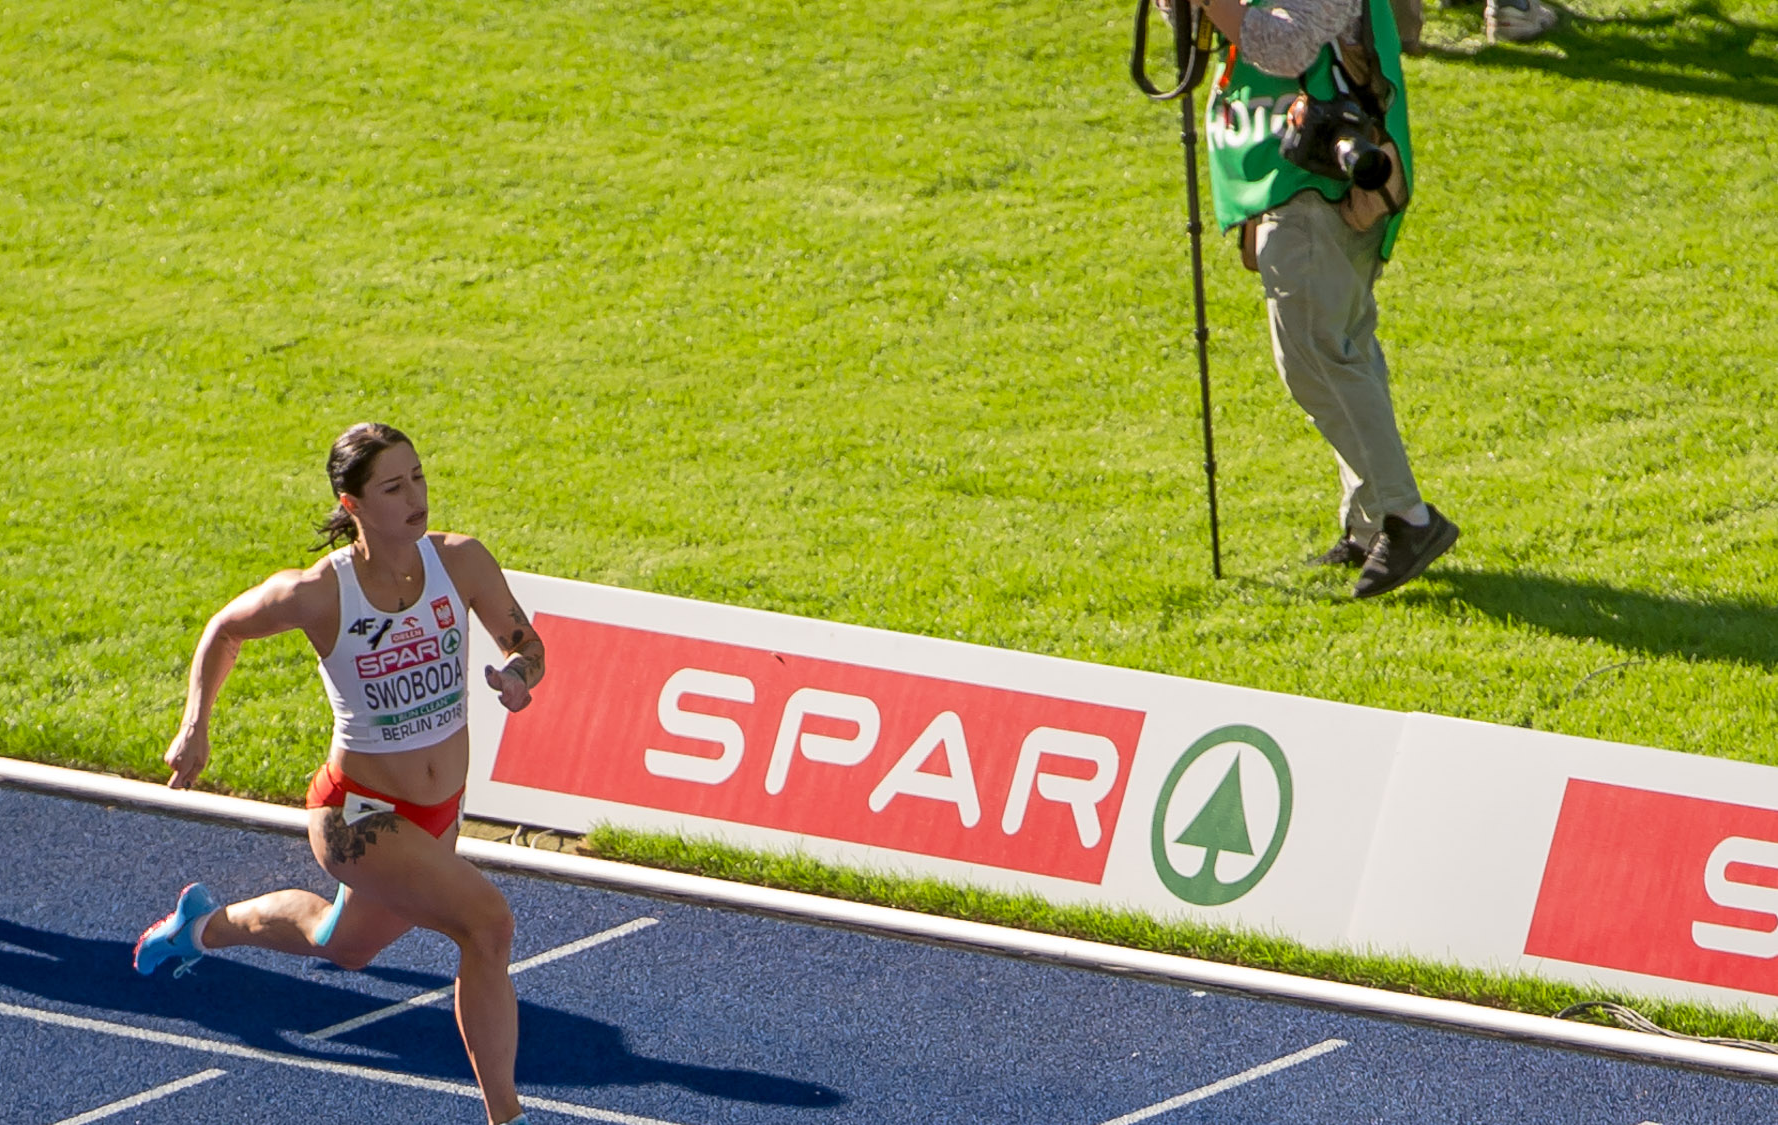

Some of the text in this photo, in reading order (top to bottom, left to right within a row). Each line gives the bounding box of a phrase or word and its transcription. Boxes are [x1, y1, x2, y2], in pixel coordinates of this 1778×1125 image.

[348, 618, 376, 636] 4F
[392, 629, 422, 642] ORLEN
[358, 639, 439, 677] SPAR
[364, 655, 464, 711] SWOBODA
[381, 702, 463, 741] BERLIN 2018
[398, 710, 419, 722] RUN
[644, 667, 1121, 850] SPAR
